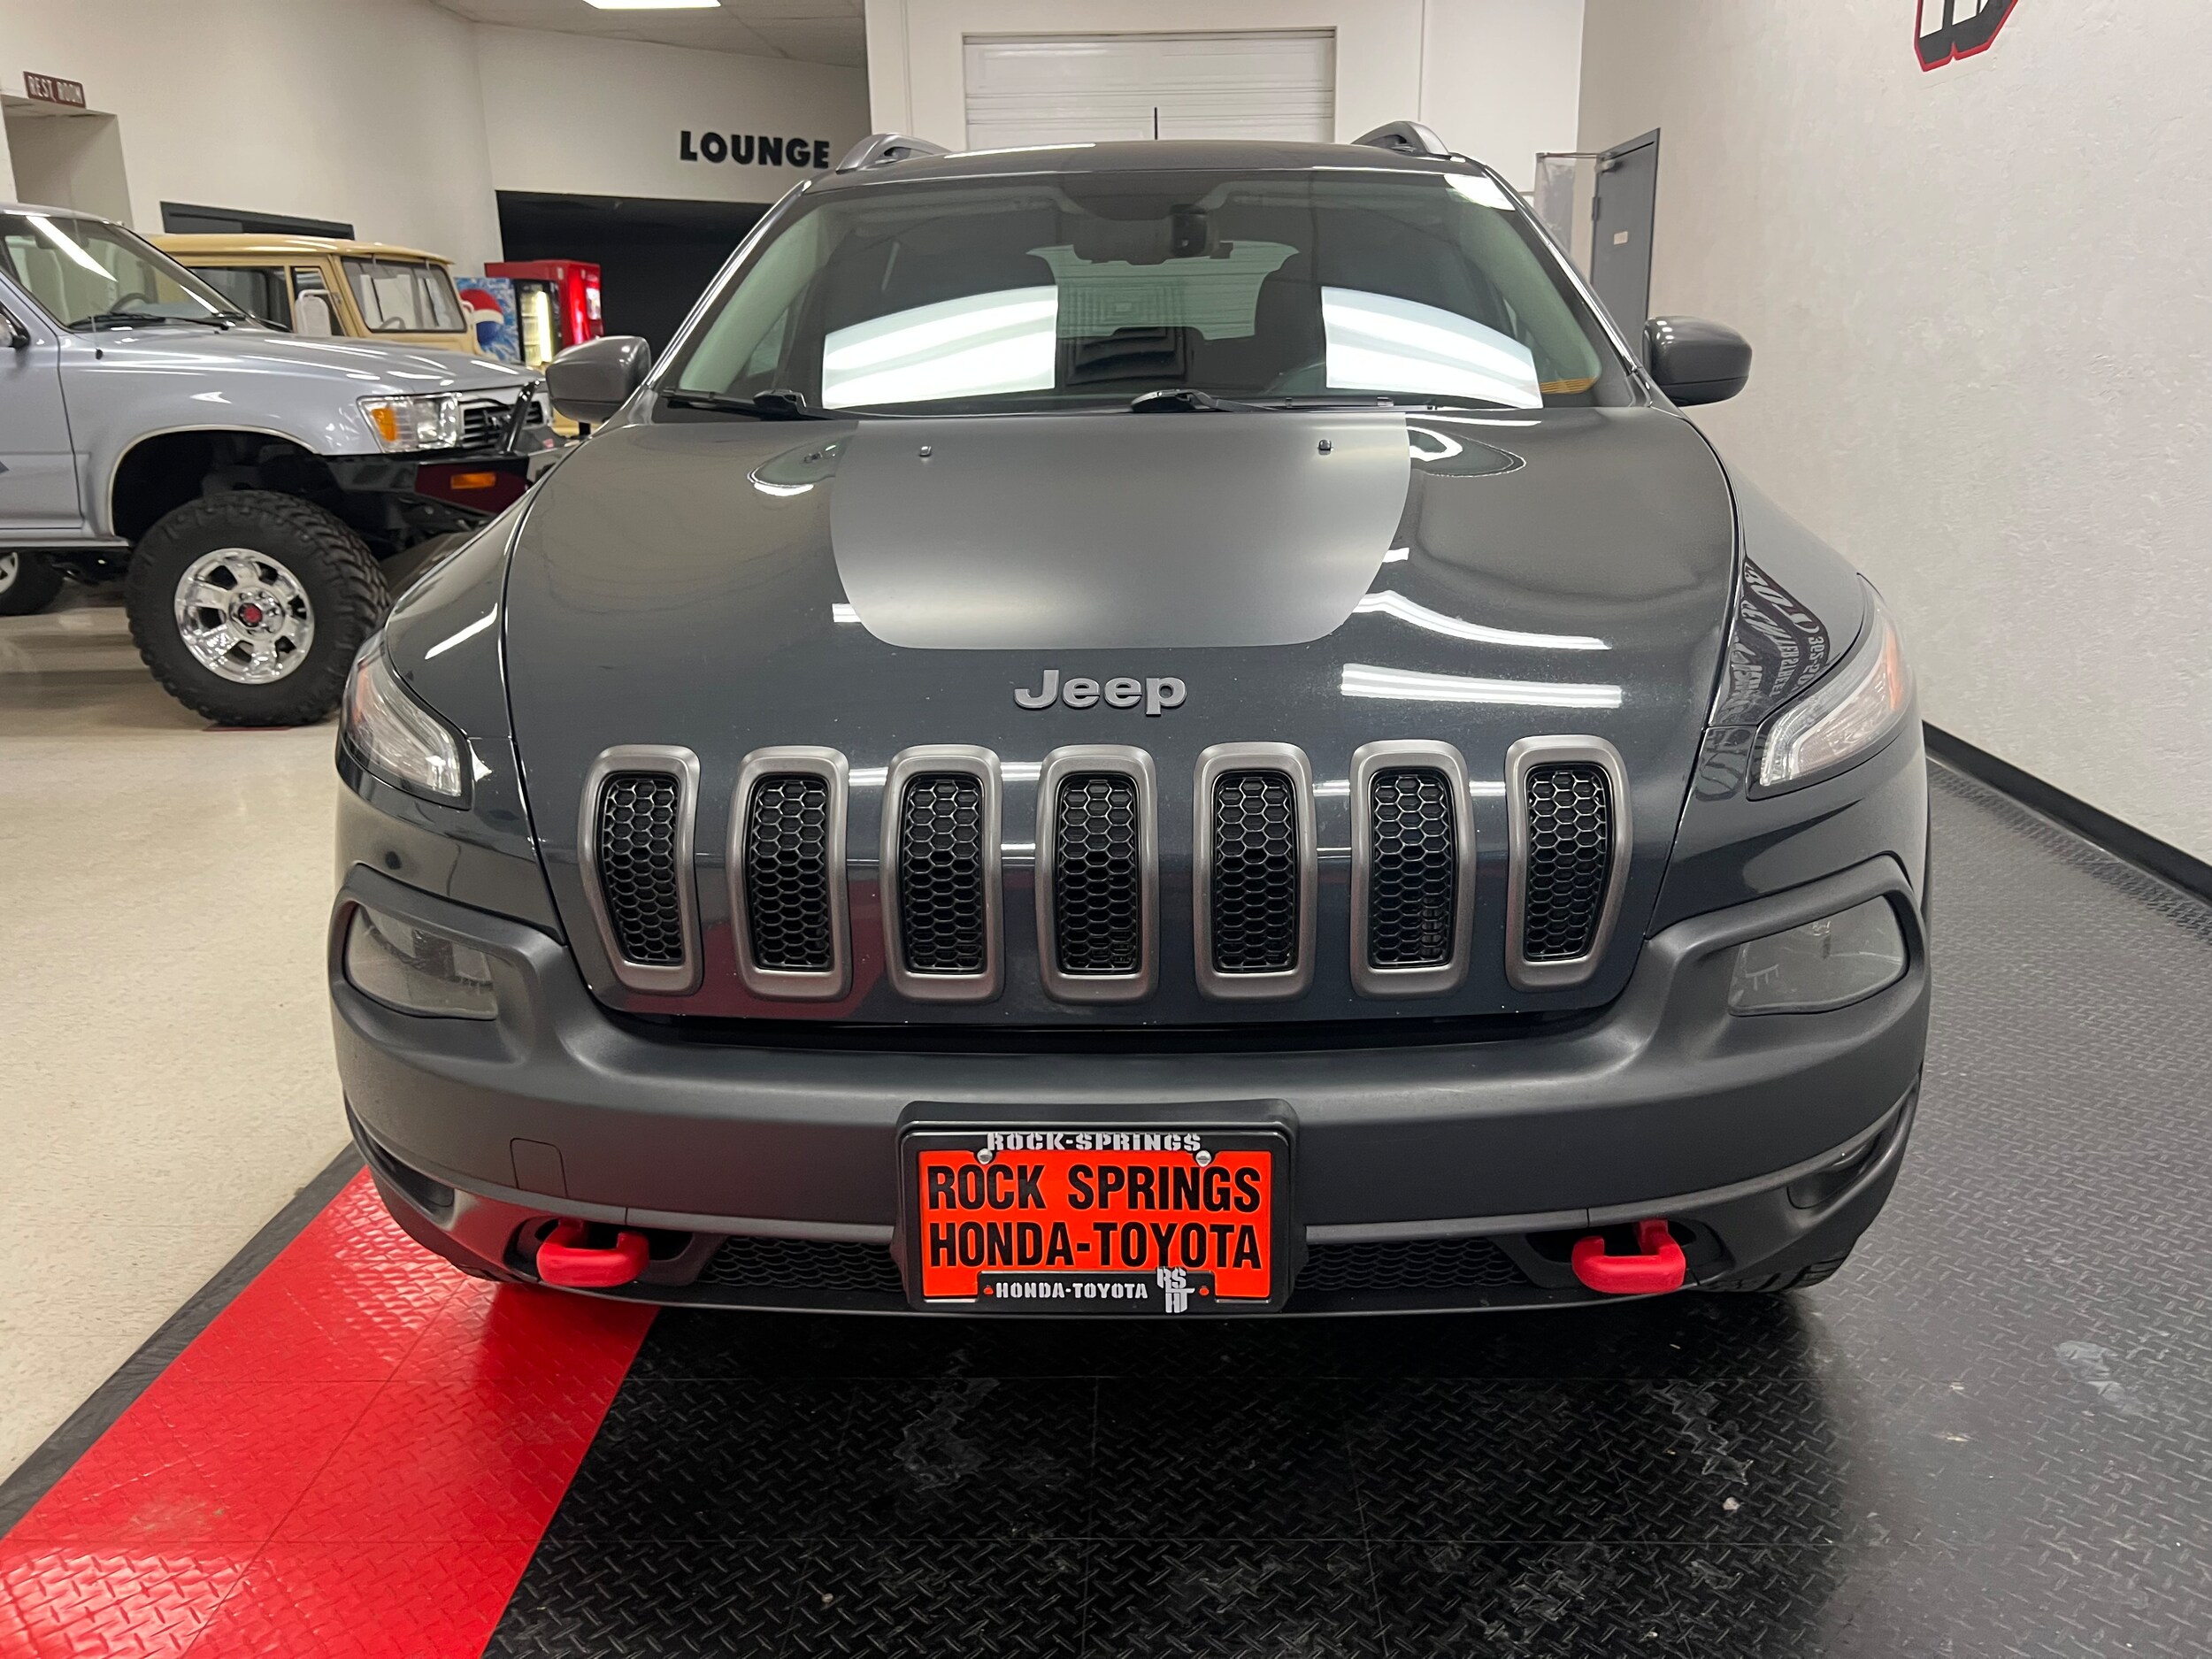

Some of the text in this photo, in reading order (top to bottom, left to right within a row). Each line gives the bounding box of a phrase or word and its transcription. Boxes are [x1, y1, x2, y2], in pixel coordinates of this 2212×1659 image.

[27, 75, 57, 102] REST
[680, 130, 830, 169] LOUNGE
[1014, 669, 1187, 718] Jeep
[927, 1164, 1262, 1213] ROCK SPRINGS
[929, 1221, 1263, 1270] HONDA-TOYOTA
[995, 1282, 1148, 1299] HONDA-TOYOTA
